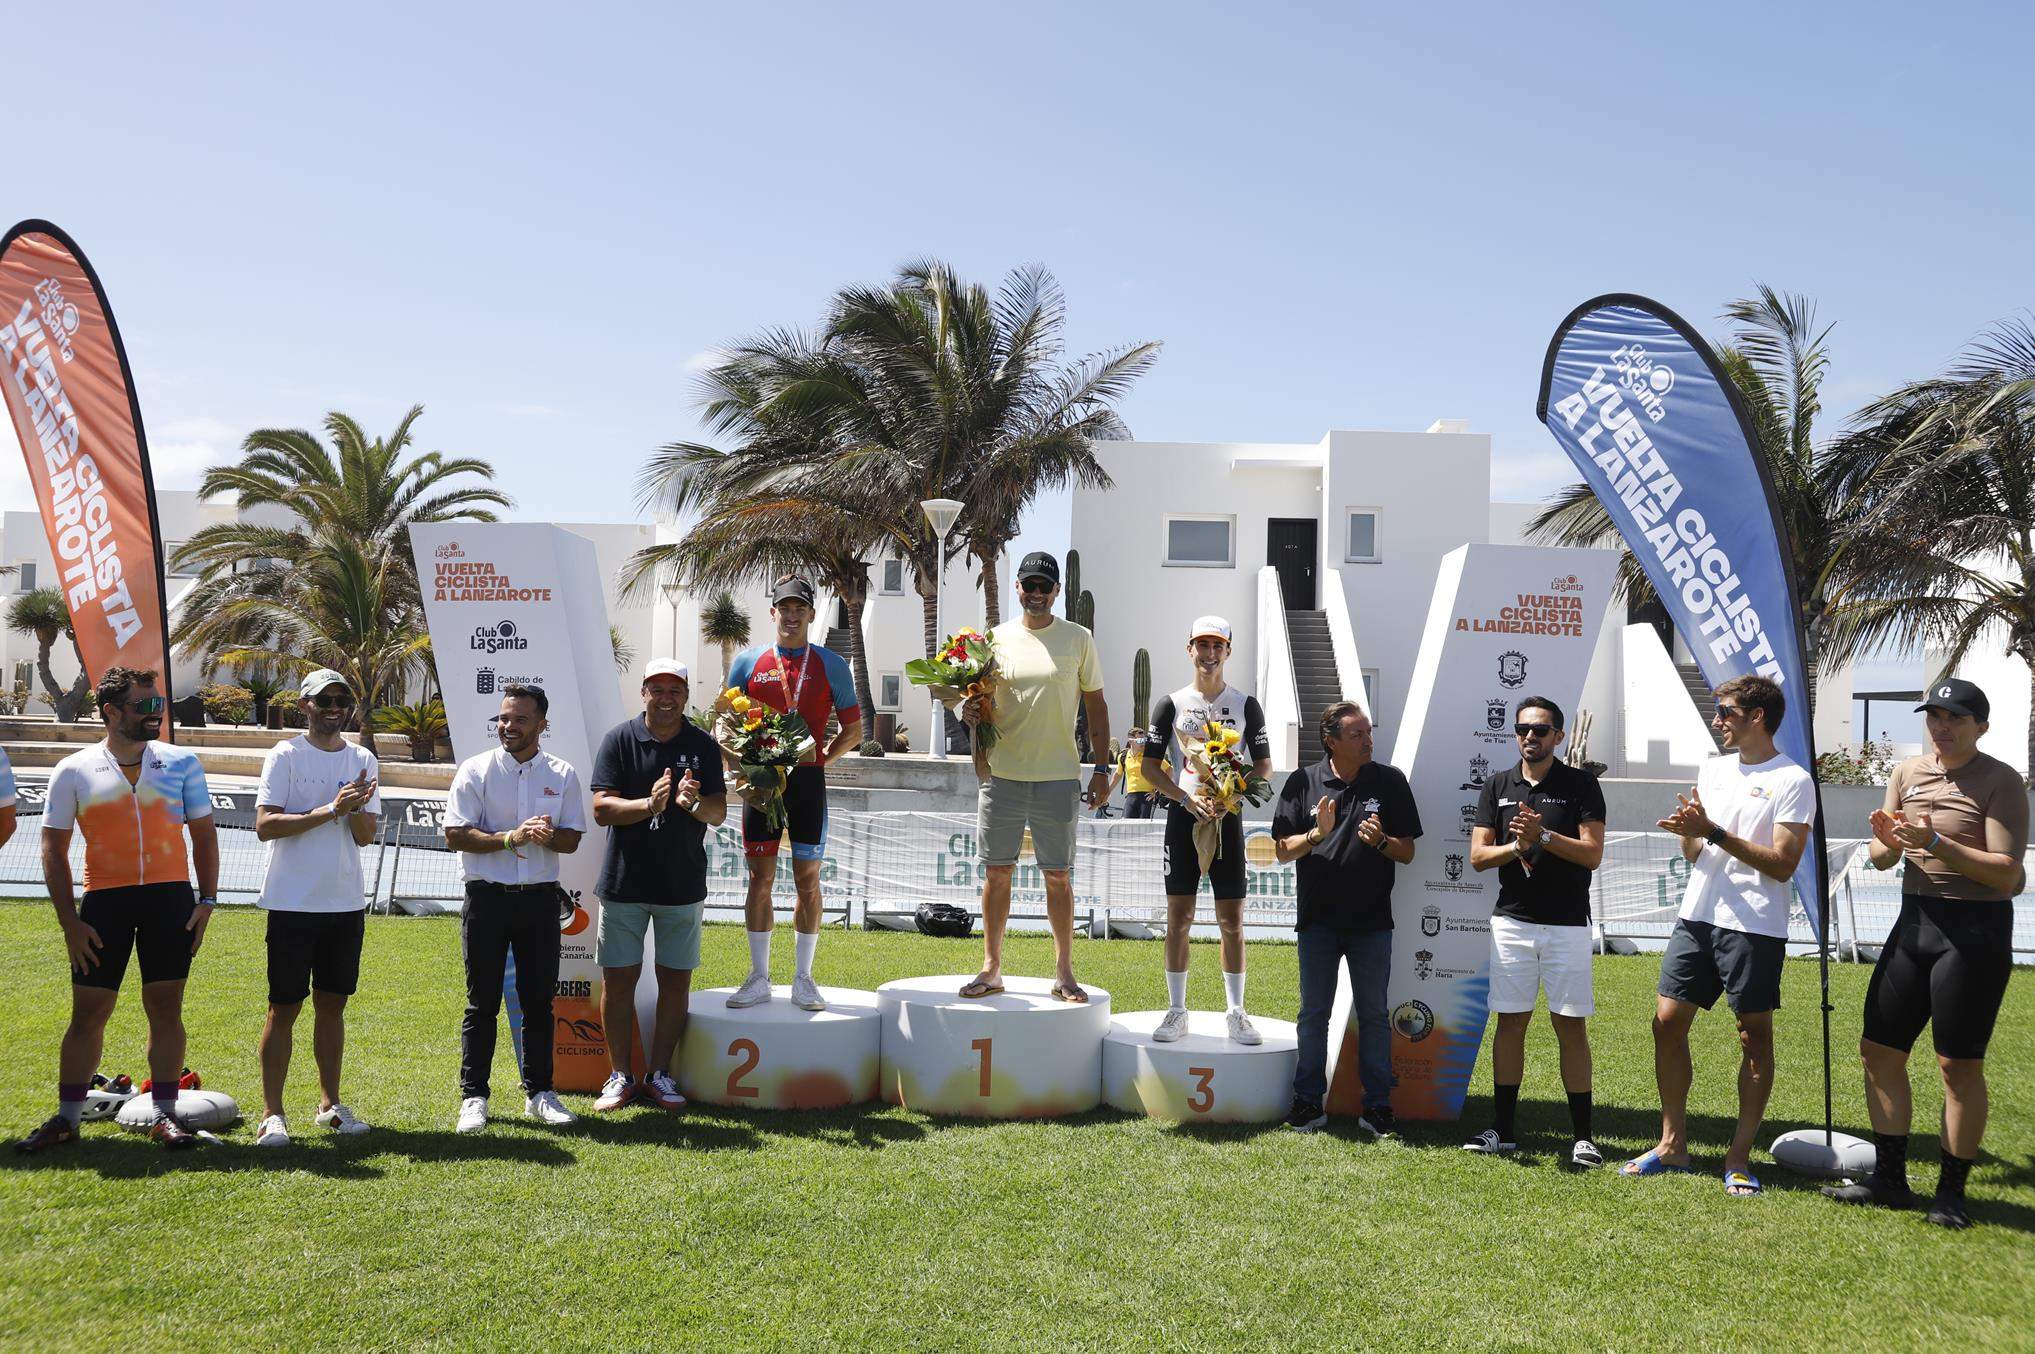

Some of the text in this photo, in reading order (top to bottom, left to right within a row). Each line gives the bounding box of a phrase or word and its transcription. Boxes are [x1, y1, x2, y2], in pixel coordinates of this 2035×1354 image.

[1629, 343, 1653, 375] Club
[14, 299, 145, 650] VUELTA CICLISTA
[1554, 392, 1737, 665] A LANZAROTE
[1581, 364, 1786, 684] VUELTA CICLISTA
[434, 563, 495, 575] VUELTA
[434, 576, 510, 588] CICLISTA
[434, 588, 552, 601] A LANZAROTE
[1517, 594, 1583, 610] VUELTA
[1500, 607, 1582, 623] CICLISTA
[475, 627, 497, 638] Club
[1455, 618, 1582, 637] A LANZAROTE
[497, 676, 544, 684] Cabildo de
[1938, 686, 1952, 698] G
[559, 952, 594, 960] Canarias
[560, 944, 586, 952] bierno
[556, 1047, 605, 1057] CICLISMO
[726, 1037, 761, 1098] 2
[971, 1037, 991, 1097] 1
[1186, 1066, 1215, 1113] 3
